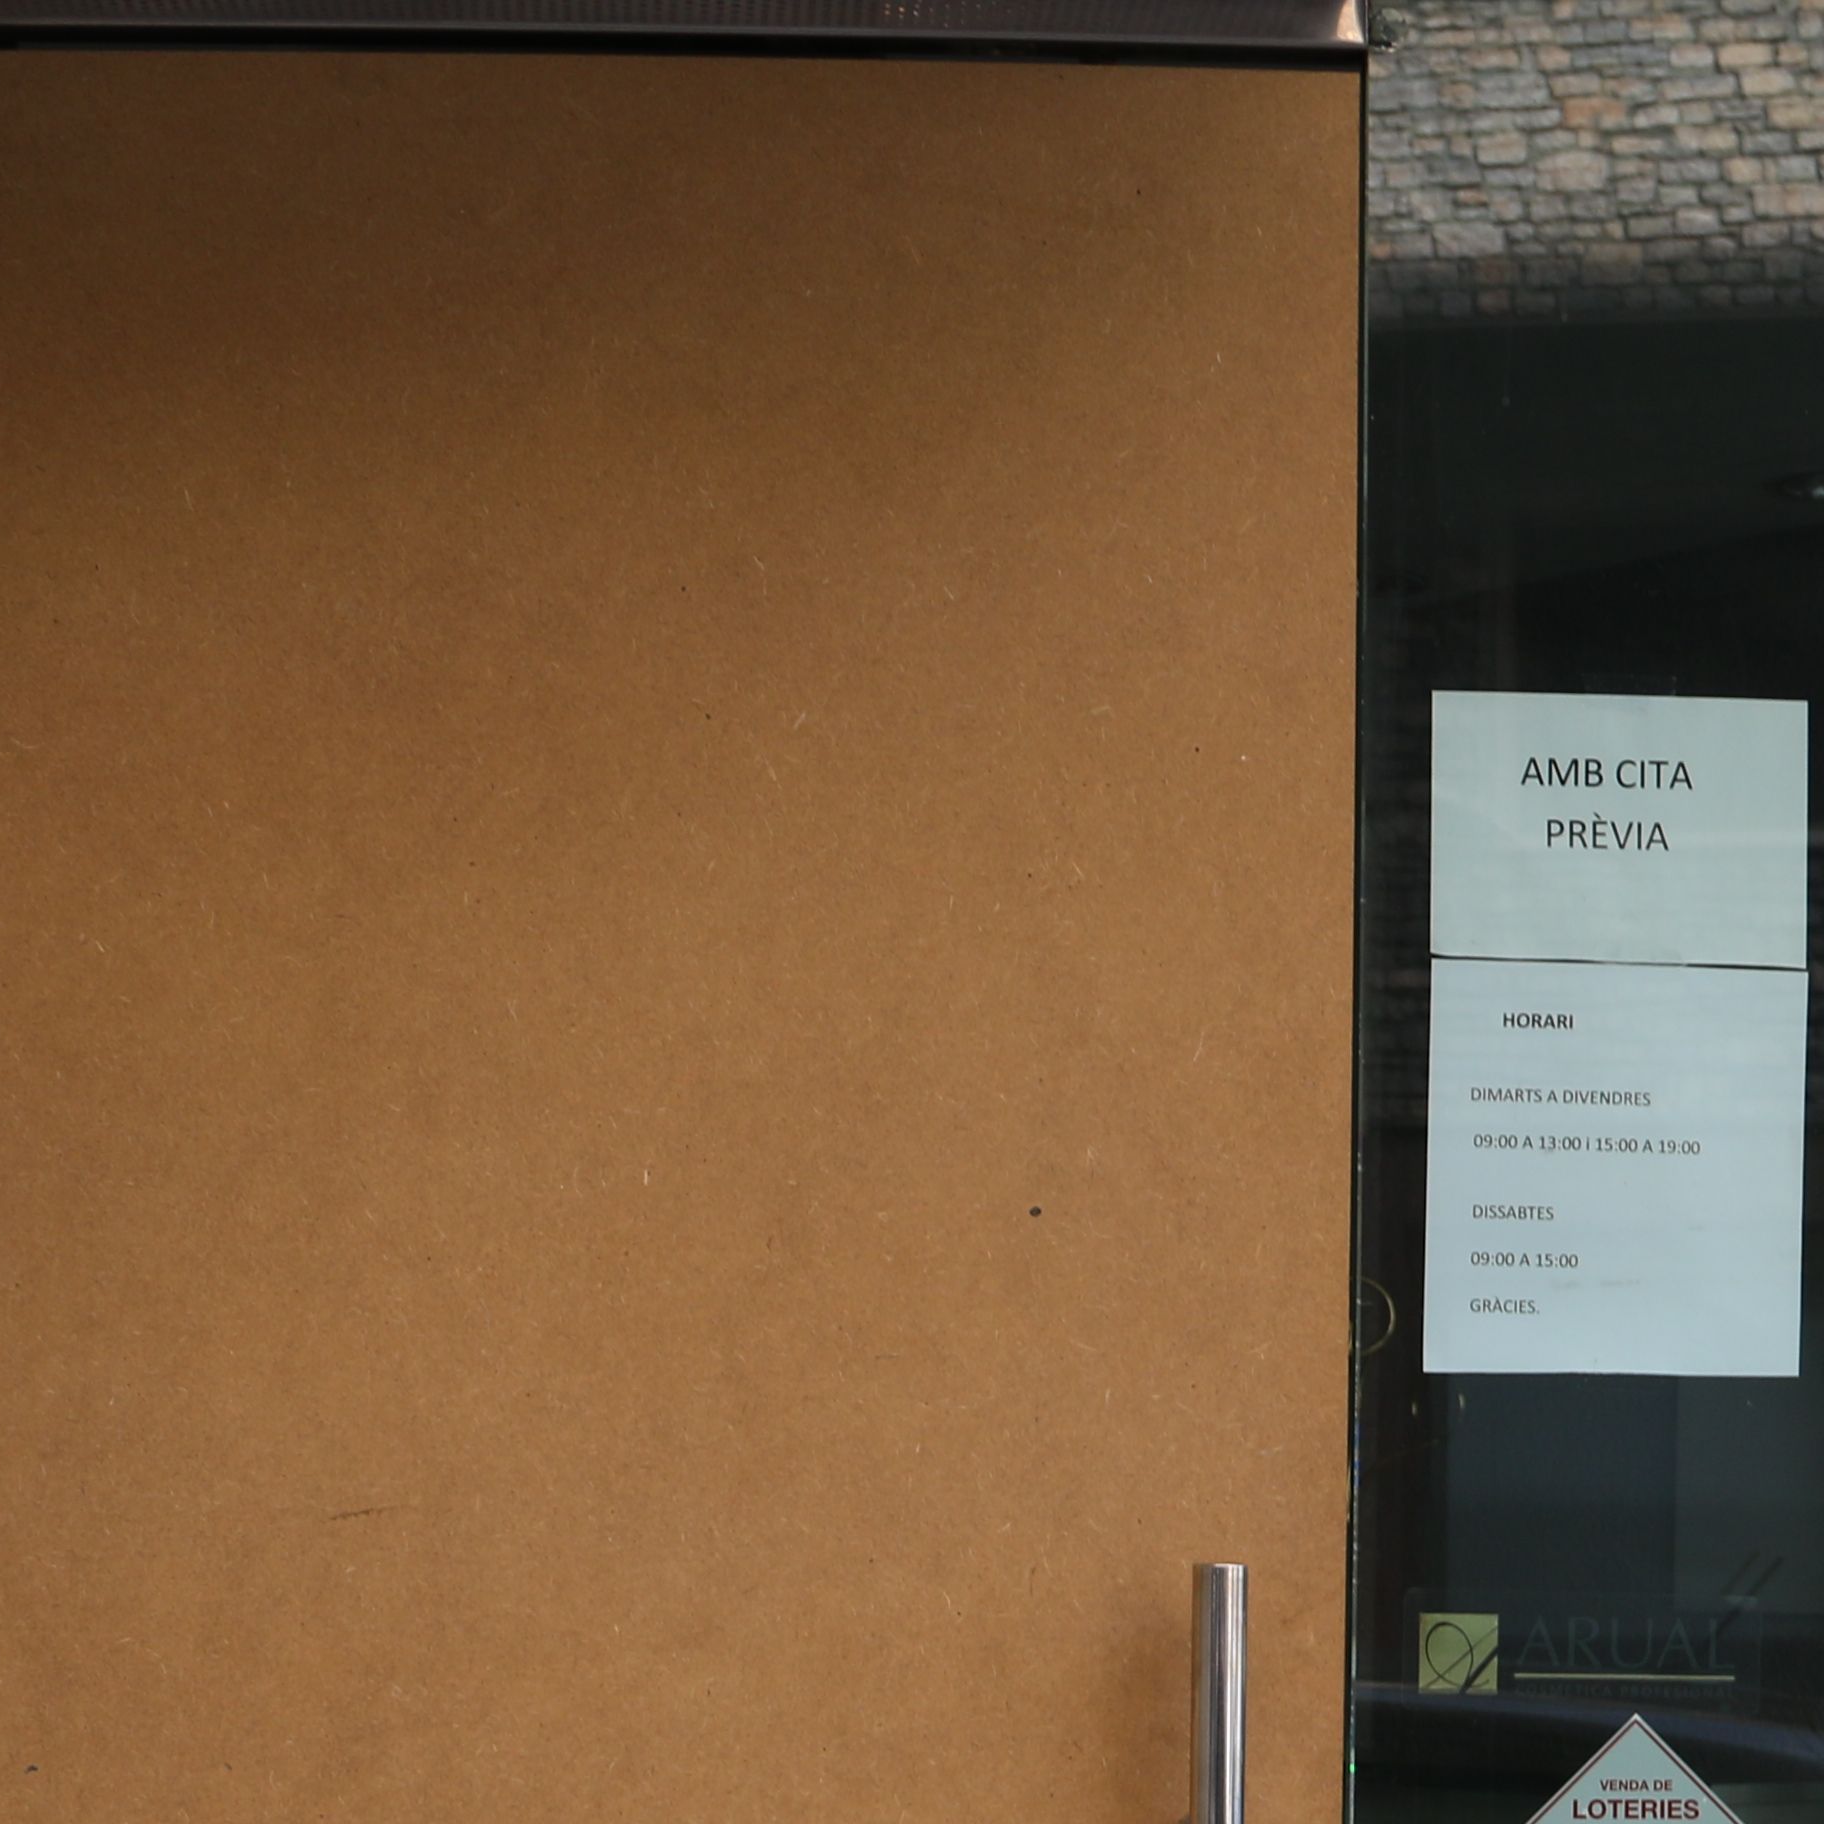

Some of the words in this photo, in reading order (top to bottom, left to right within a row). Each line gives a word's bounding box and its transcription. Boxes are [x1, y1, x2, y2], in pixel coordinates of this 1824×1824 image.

[1520, 756, 1604, 788] AMB
[1615, 759, 1693, 791] CITA
[1545, 811, 1670, 852] PRÈVIA
[1502, 1012, 1575, 1030] HORARI
[1470, 1087, 1543, 1103] DIMARTS
[1547, 1089, 1558, 1103] A
[1563, 1090, 1651, 1107] DIVENDRES
[1473, 1134, 1518, 1150] 09:00
[1522, 1136, 1534, 1150] A
[1538, 1136, 1582, 1152] 13:00
[1596, 1137, 1638, 1153] 15:00
[1642, 1139, 1653, 1153] A
[1658, 1139, 1701, 1155] 19:00
[1472, 1204, 1554, 1221] DISSABTES
[1470, 1252, 1515, 1267] 09:00
[1519, 1253, 1531, 1267] A
[1535, 1253, 1578, 1269] 15:00
[1469, 1296, 1540, 1315] GRÀCIES.
[1515, 1613, 1736, 1671] ARUAL
[1600, 1779, 1650, 1792] VENDA
[1653, 1780, 1673, 1792] DE
[1572, 1799, 1700, 1820] LOTERIES
